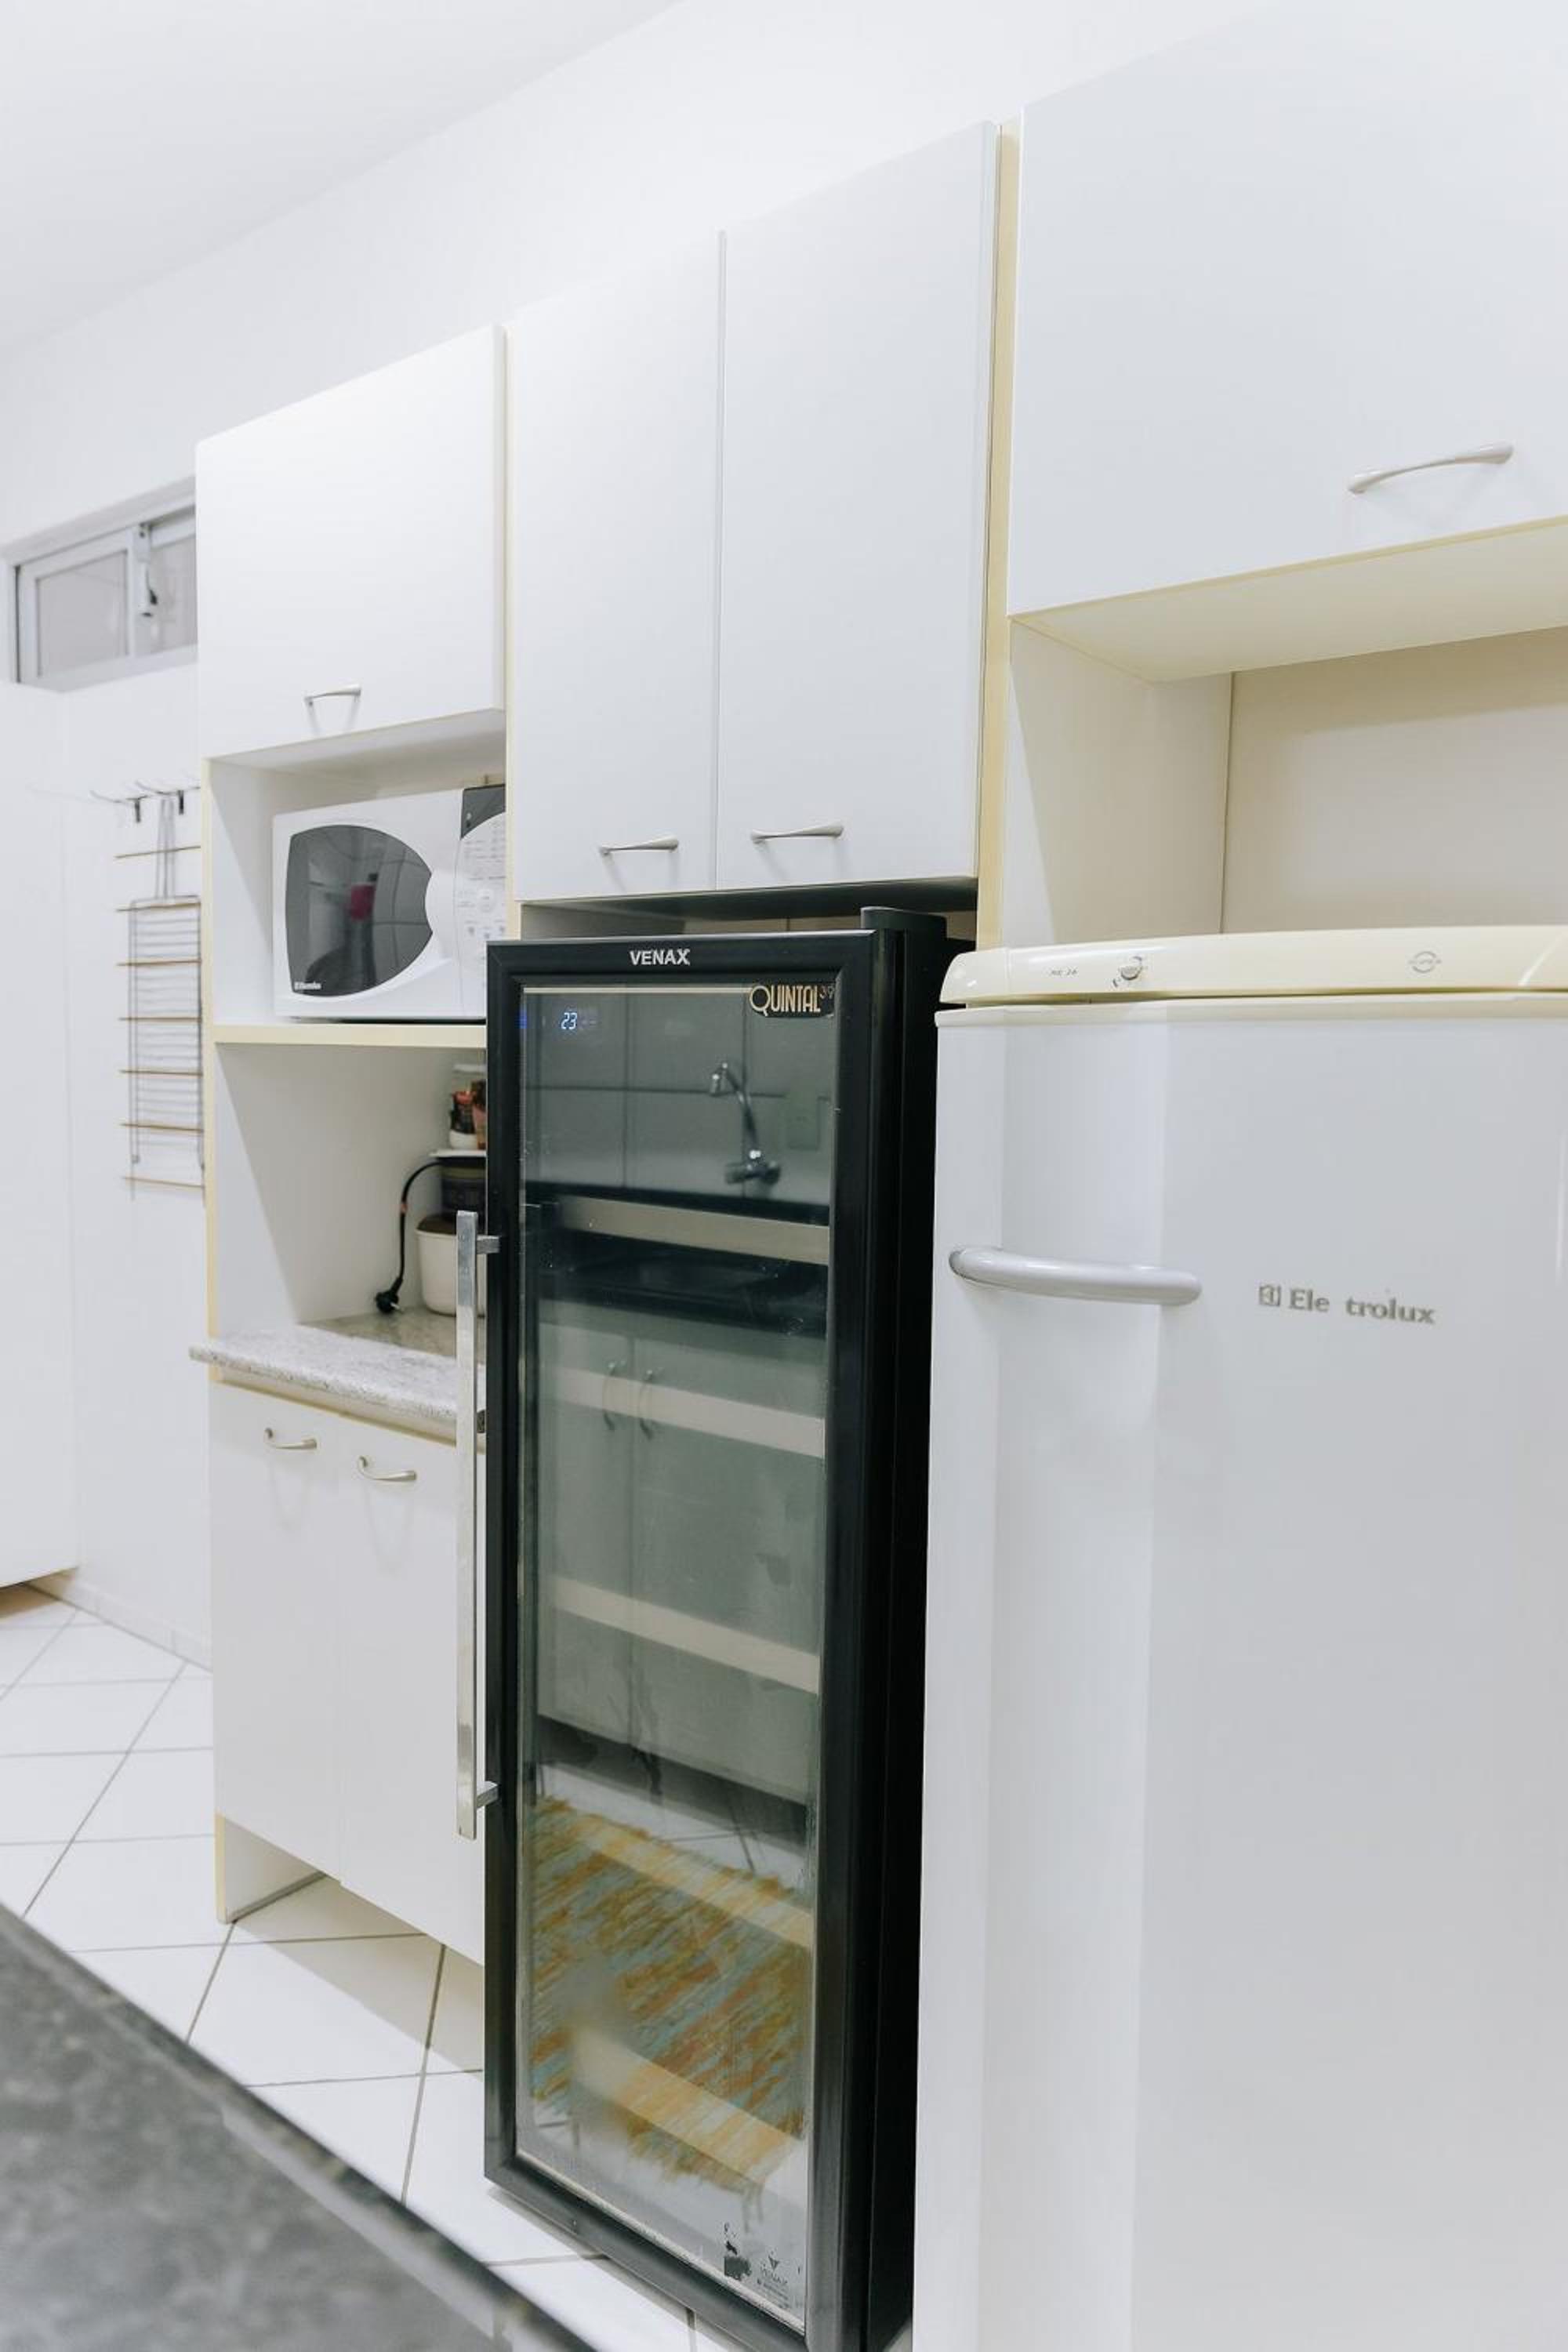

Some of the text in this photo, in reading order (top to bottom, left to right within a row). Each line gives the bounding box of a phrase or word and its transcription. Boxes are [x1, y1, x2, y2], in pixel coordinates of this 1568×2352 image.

[630, 949, 690, 965] VENAX
[750, 985, 821, 1017] QUINTAL
[561, 1012, 578, 1029] 23
[1288, 1288, 1436, 1324] Eletrolux
